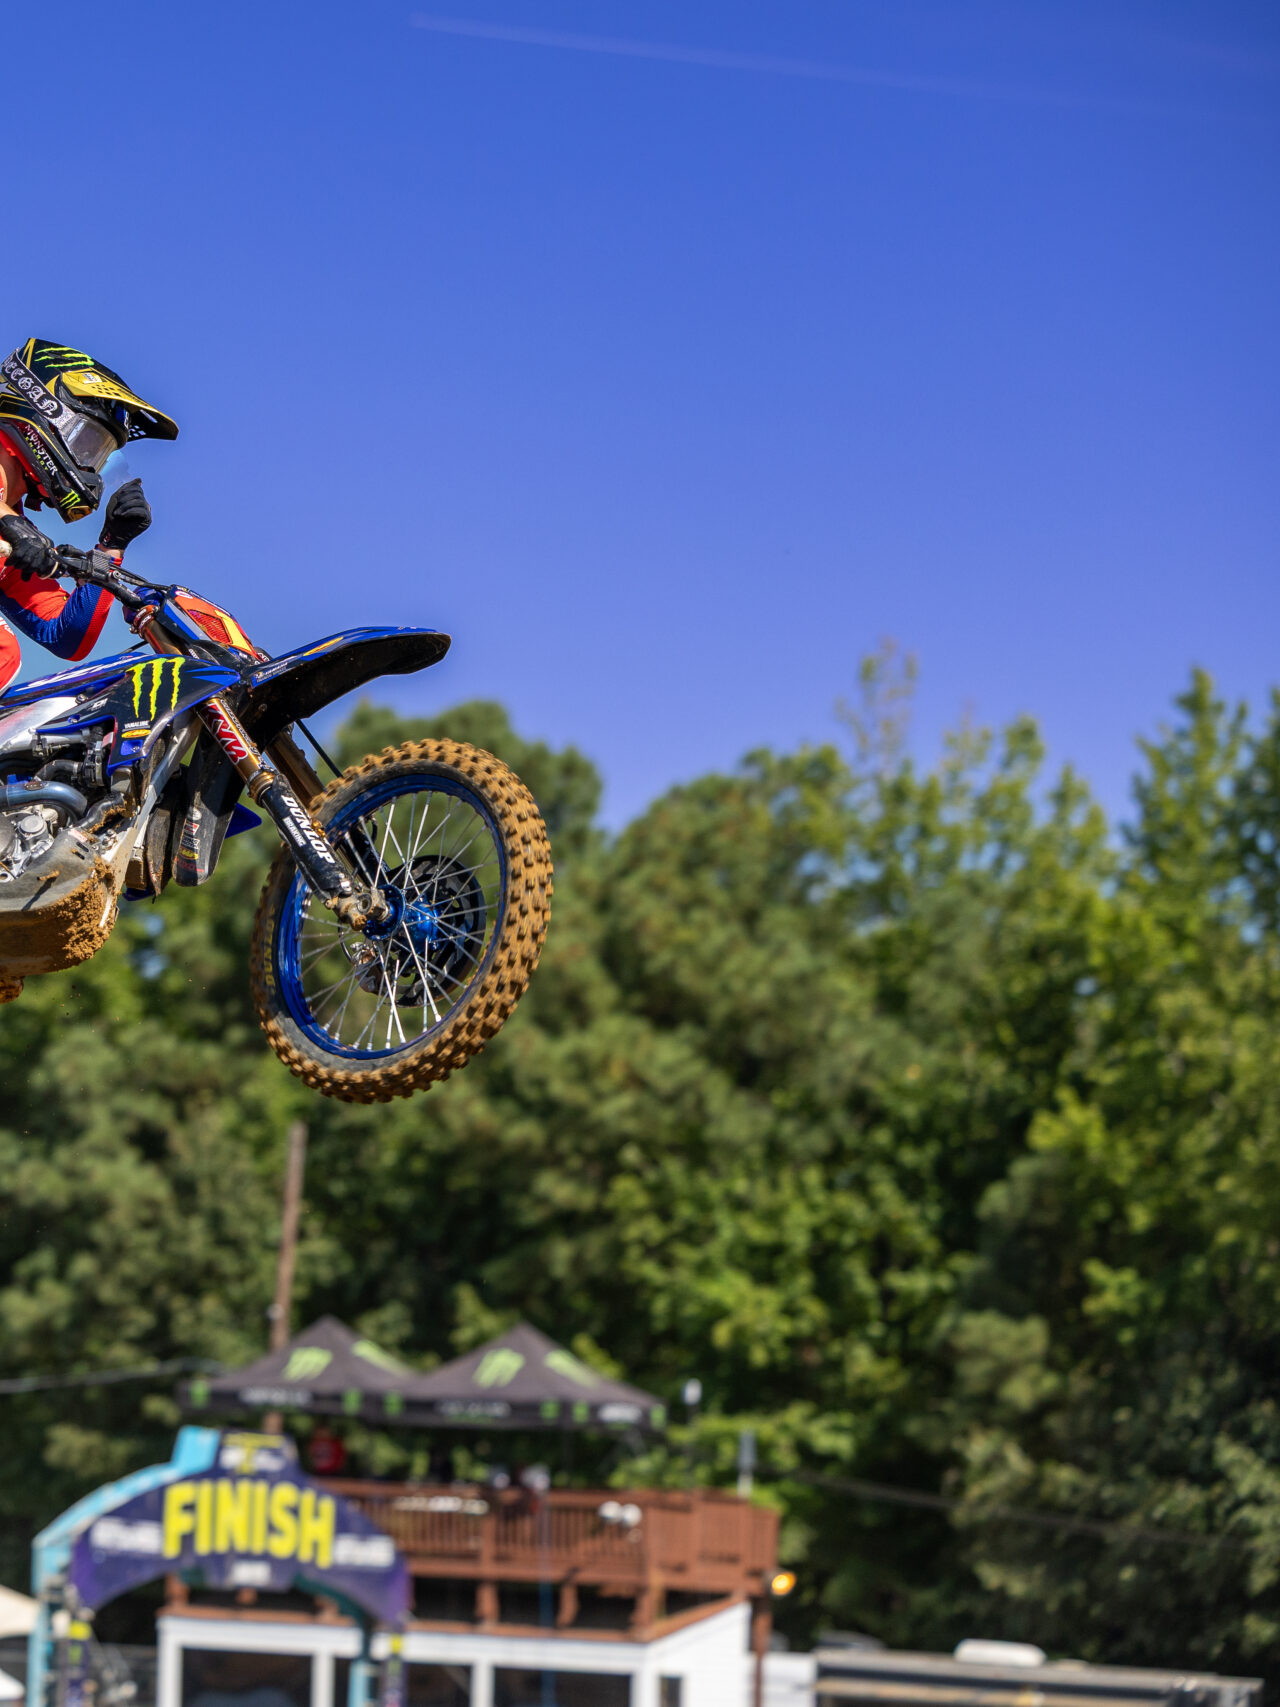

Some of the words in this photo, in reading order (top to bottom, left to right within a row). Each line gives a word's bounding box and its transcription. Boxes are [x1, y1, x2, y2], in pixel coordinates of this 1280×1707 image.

[25, 424, 58, 476] MONSTER
[281, 795, 335, 864] DUNLOP
[163, 1479, 335, 1568] FINISH
